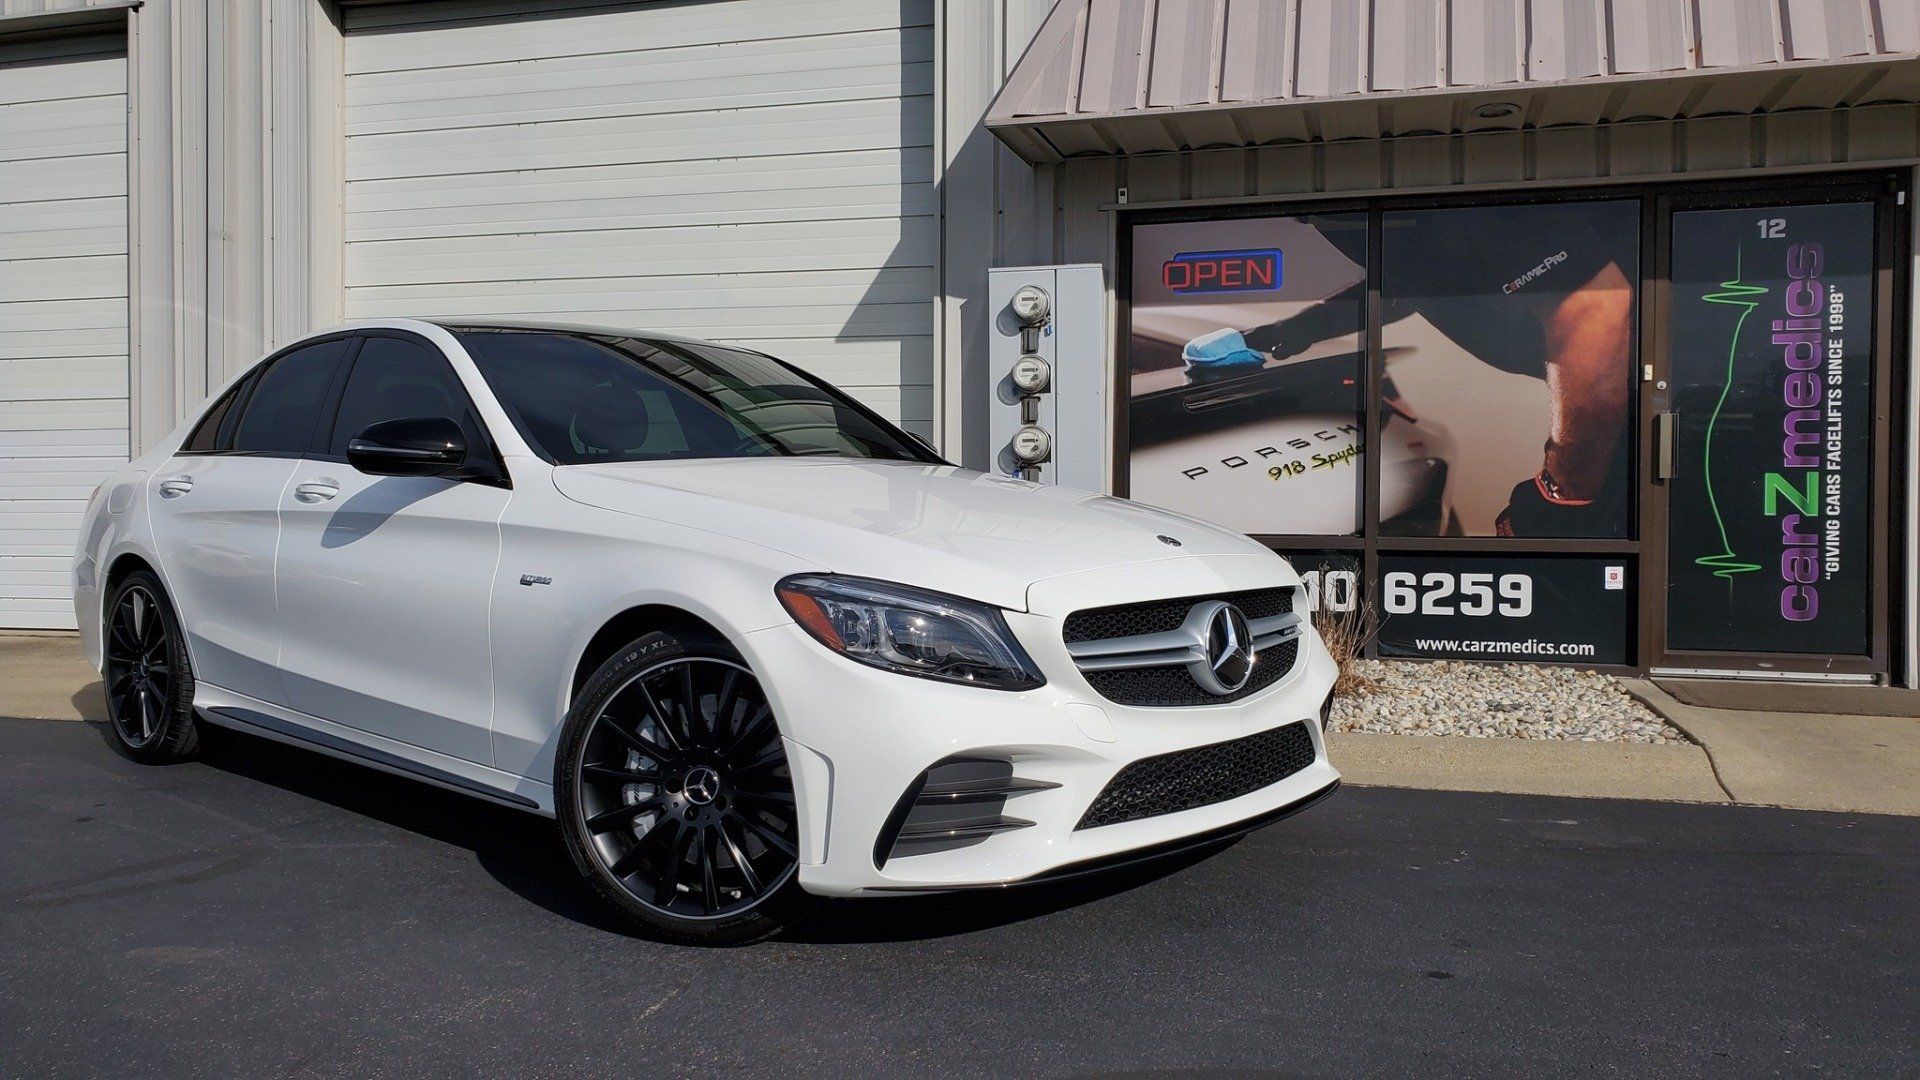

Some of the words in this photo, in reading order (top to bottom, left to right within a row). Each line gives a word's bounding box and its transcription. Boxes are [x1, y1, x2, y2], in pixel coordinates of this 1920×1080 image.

[1757, 218, 1787, 238] 12
[1163, 257, 1272, 289] OPEN
[1828, 338, 1844, 385] SINCE
[1763, 243, 1824, 621] carZmedics
[1826, 388, 1843, 470] FACELIFTS
[1181, 423, 1365, 481] PORSCH
[1268, 460, 1306, 481] 918
[1826, 476, 1841, 516] CARS
[1384, 571, 1533, 617] 6259
[1415, 638, 1595, 656] www.carzmedics.com
